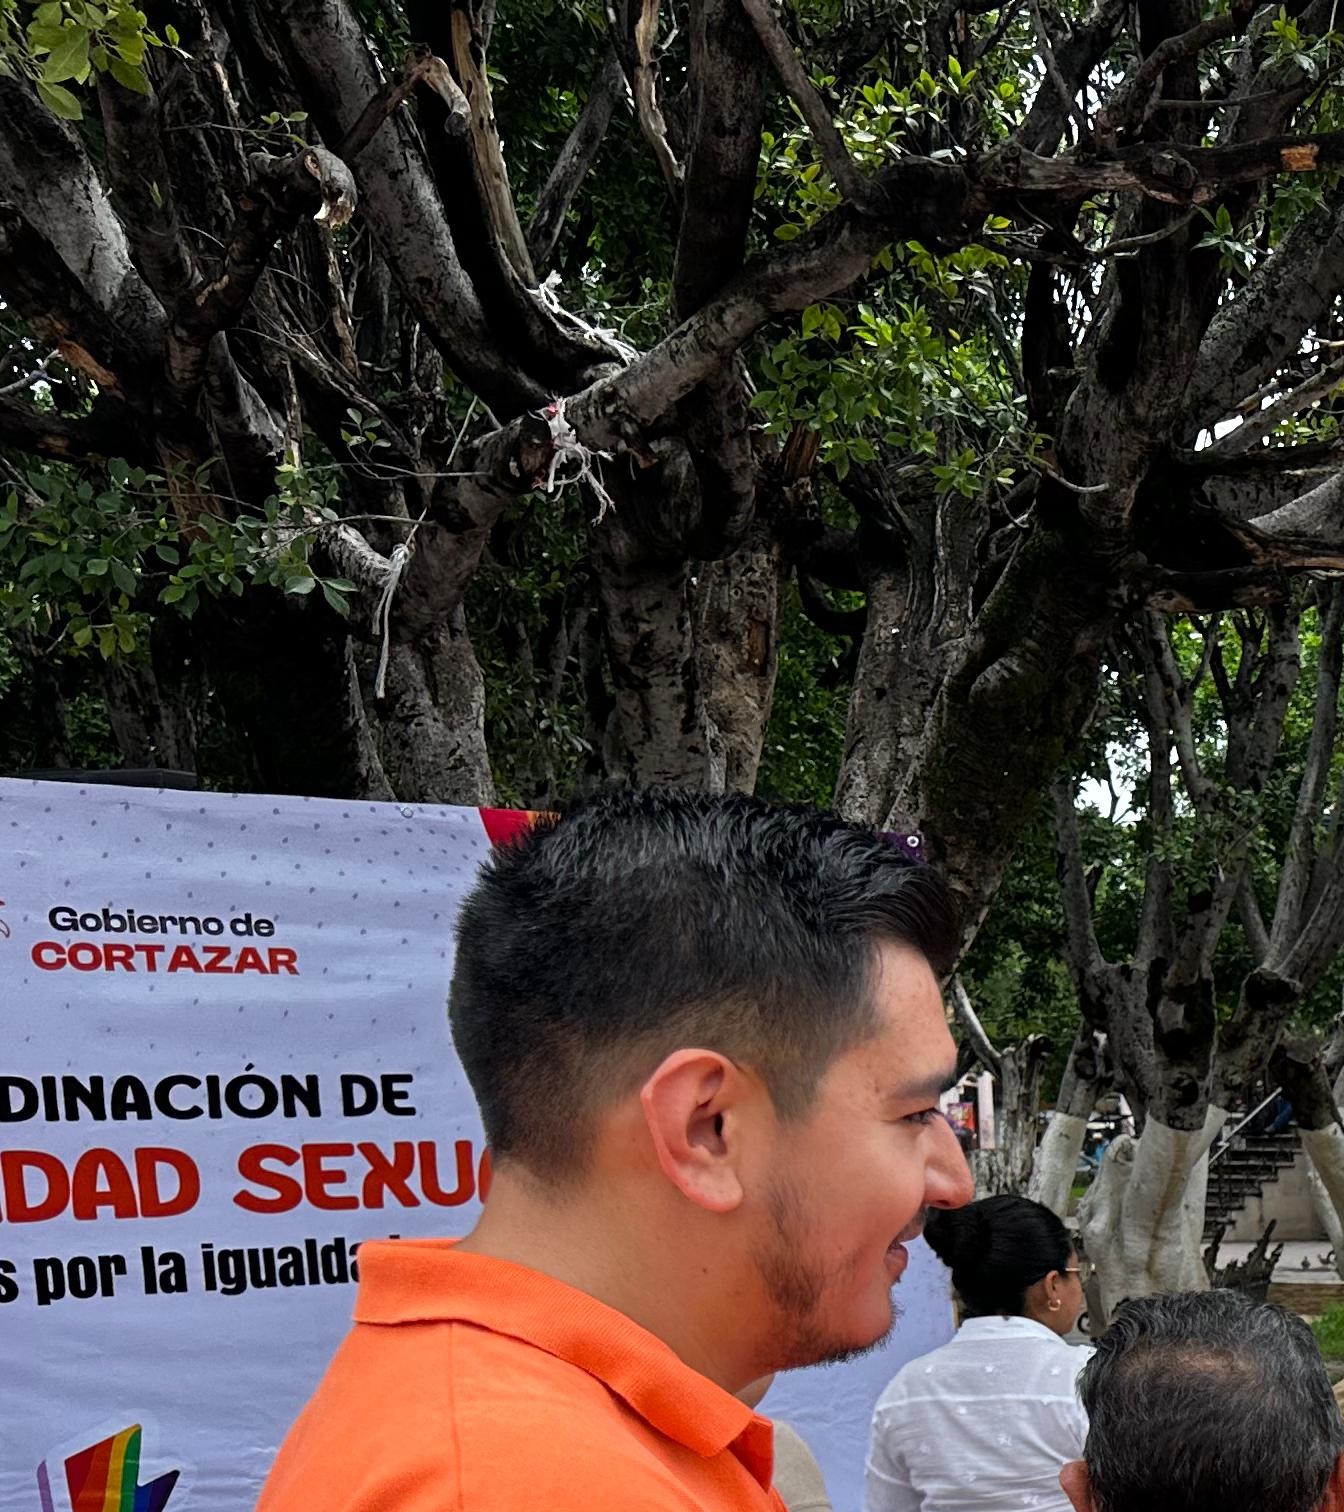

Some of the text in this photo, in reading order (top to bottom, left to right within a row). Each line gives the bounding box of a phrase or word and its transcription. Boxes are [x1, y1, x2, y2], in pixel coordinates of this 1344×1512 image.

[49, 906, 275, 937] Gobierno de
[31, 941, 299, 975] CORTAZAR
[0, 1064, 417, 1122] DINACIÓN DE
[0, 1140, 492, 1224] DAD SEXU
[33, 1254, 127, 1307] por
[142, 1247, 188, 1296] la
